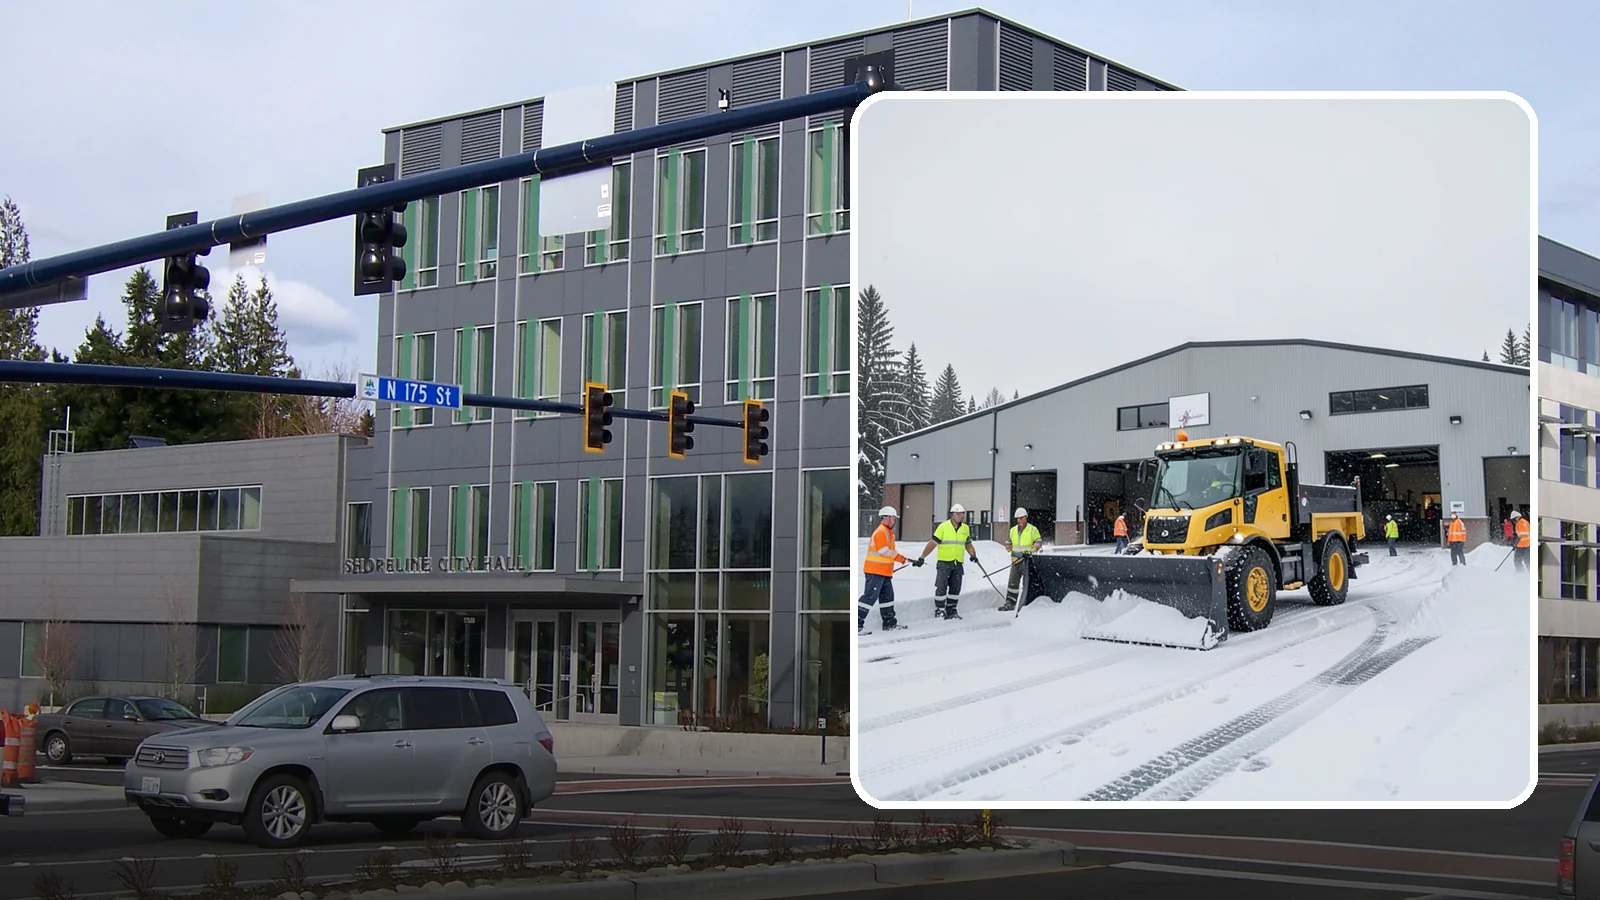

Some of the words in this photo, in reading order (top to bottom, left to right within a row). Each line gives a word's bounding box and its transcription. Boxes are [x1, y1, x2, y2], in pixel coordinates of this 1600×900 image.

[387, 380, 396, 400] N
[405, 382, 428, 403] 175
[436, 386, 451, 406] St
[344, 557, 432, 574] SHORELINE
[438, 556, 477, 572] CITY
[484, 556, 526, 571] HALL
